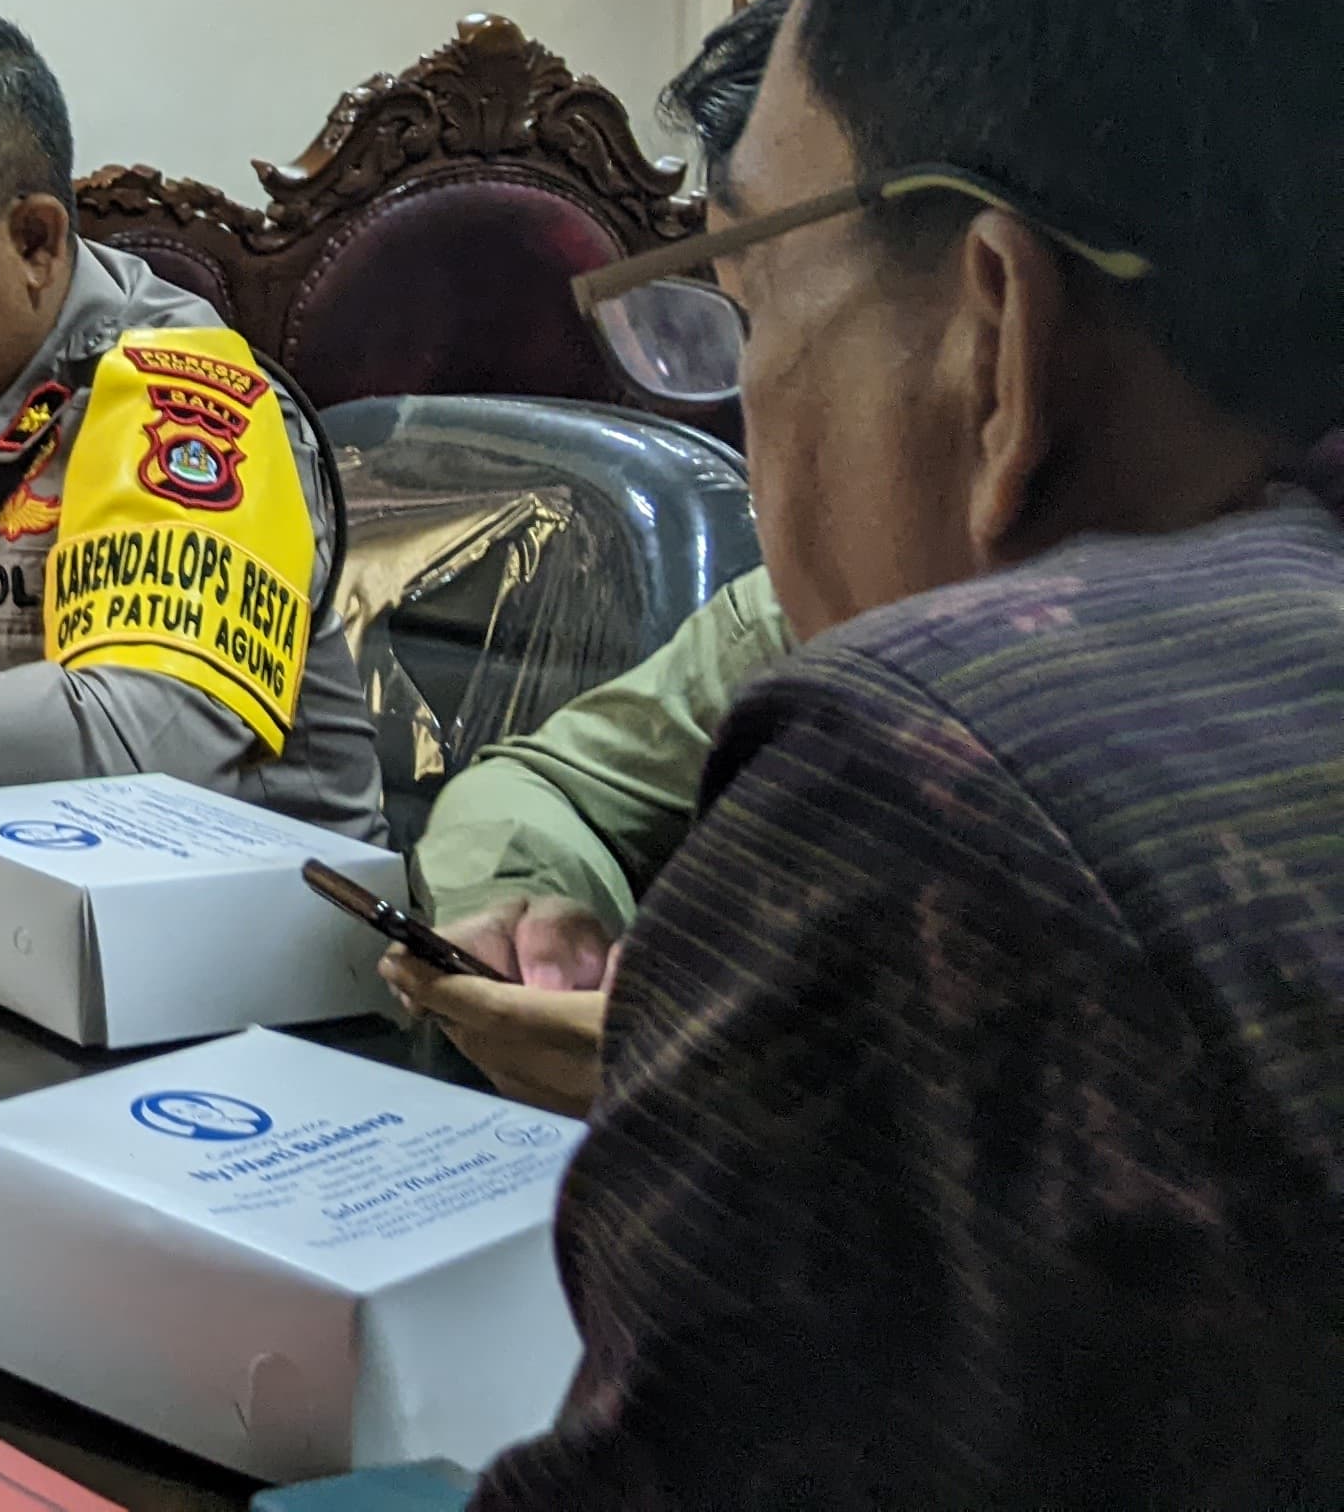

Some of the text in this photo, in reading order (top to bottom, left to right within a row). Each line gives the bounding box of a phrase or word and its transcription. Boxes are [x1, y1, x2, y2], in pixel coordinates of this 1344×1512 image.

[171, 389, 232, 421] BALI
[55, 528, 298, 660] KARENDALOPS RESTA
[58, 592, 286, 697] OPS PATUH AGUNG
